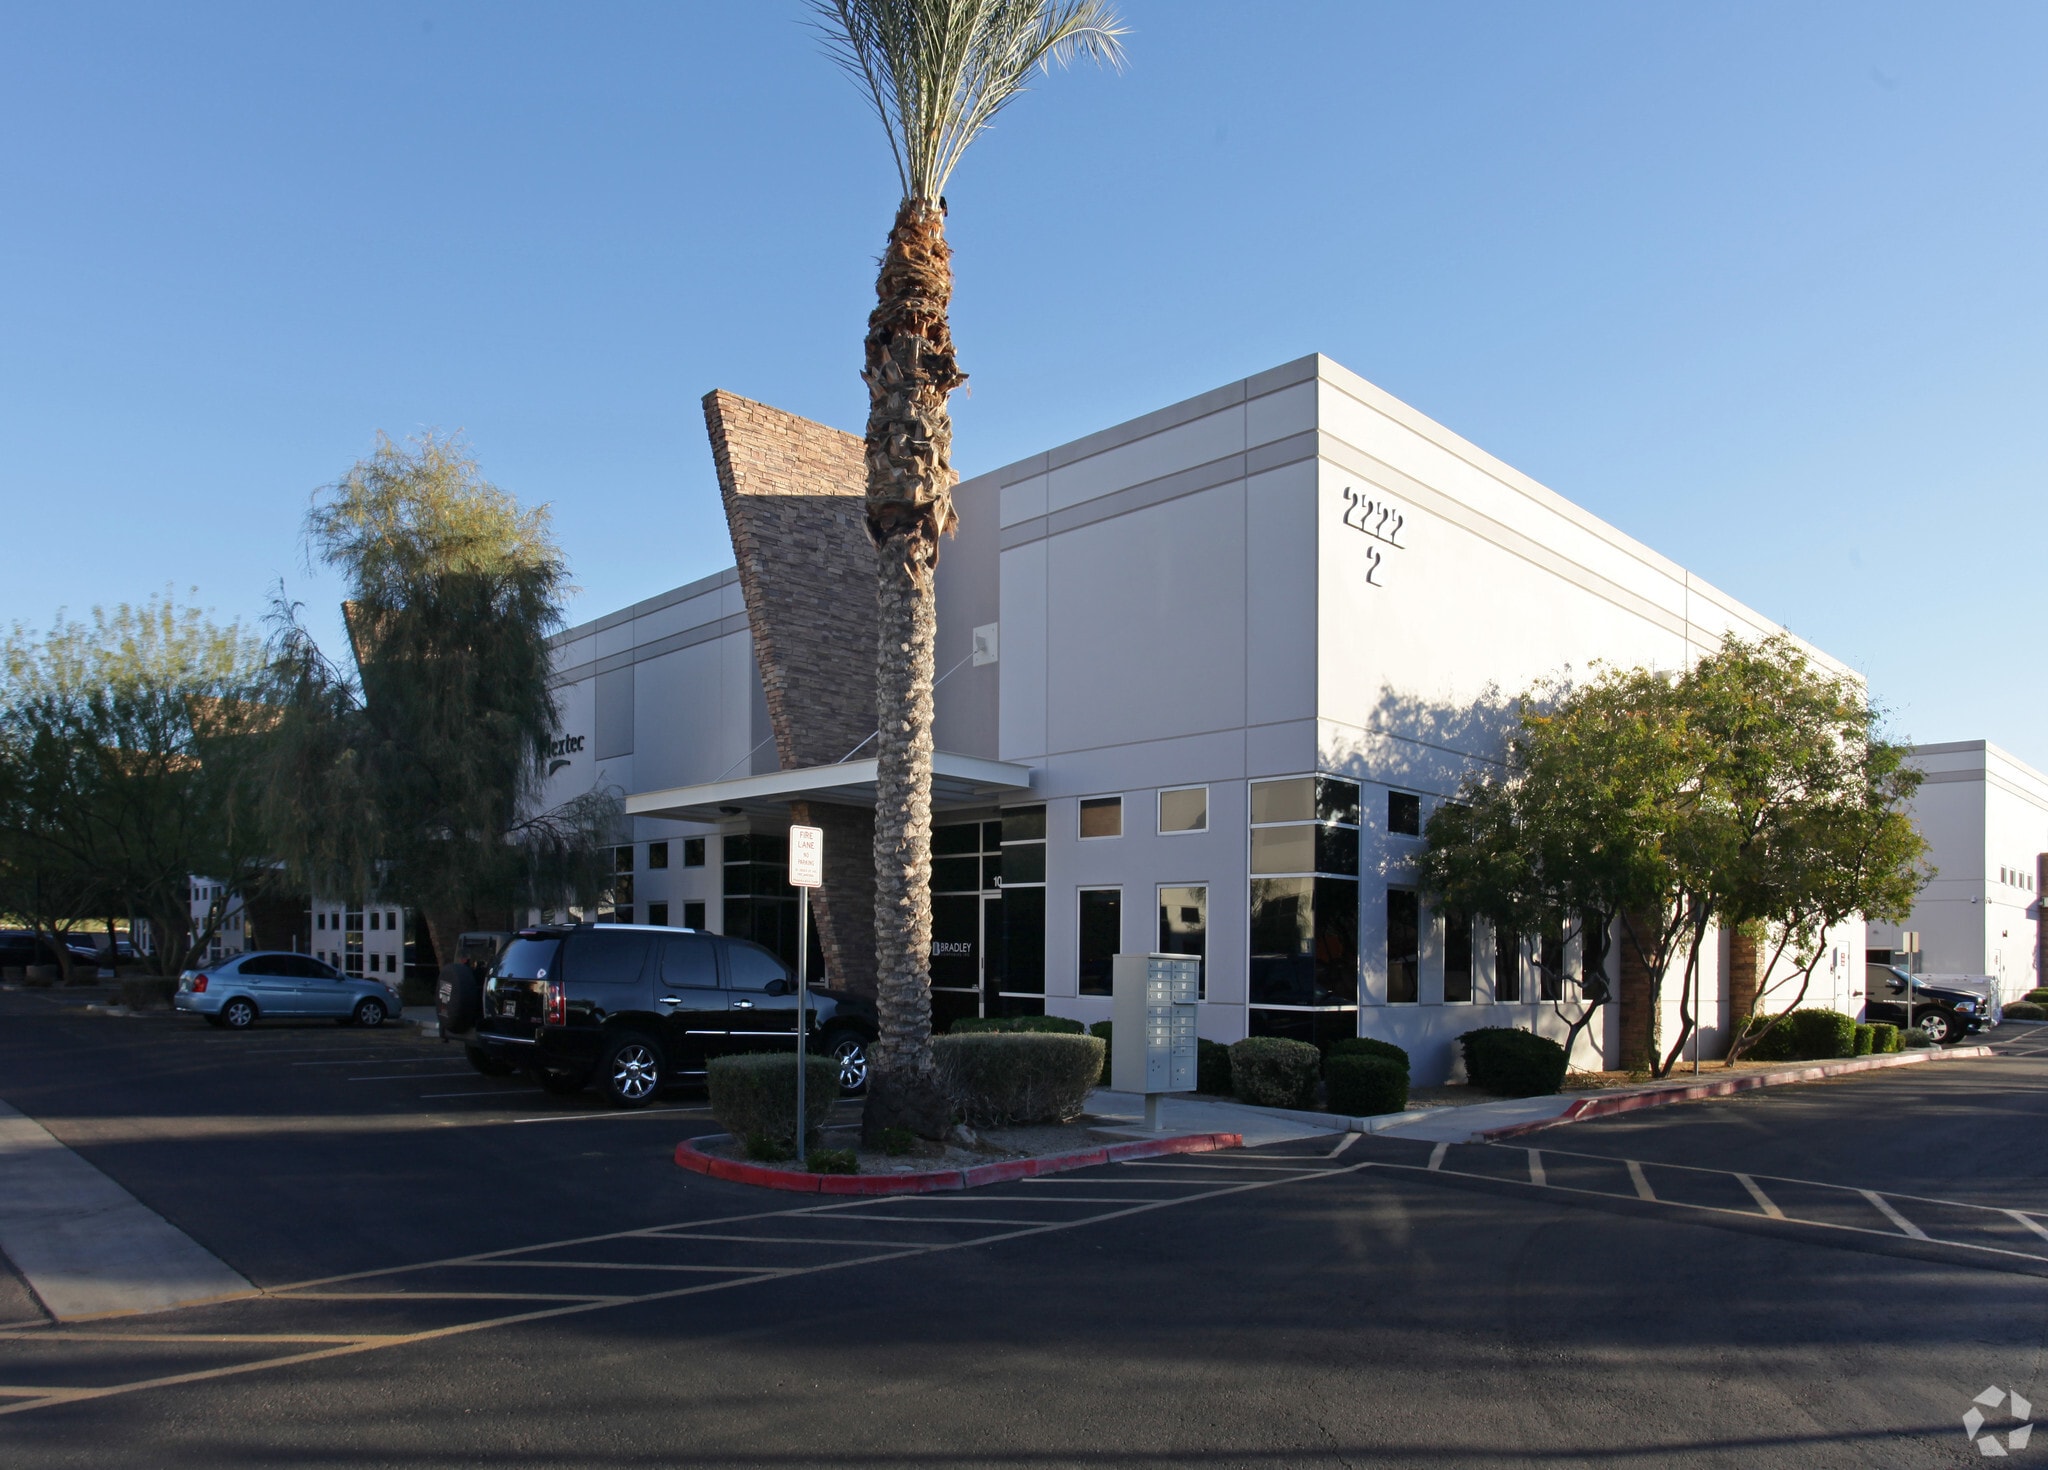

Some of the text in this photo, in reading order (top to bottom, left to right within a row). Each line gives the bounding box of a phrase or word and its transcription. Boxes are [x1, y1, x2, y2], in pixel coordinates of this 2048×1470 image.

[1342, 486, 1406, 550] 2222
[1366, 546, 1383, 588] 2
[799, 831, 814, 840] FIRE
[797, 841, 815, 850] LANE
[797, 859, 815, 867] PARKING
[940, 942, 972, 953] BRADLEY
